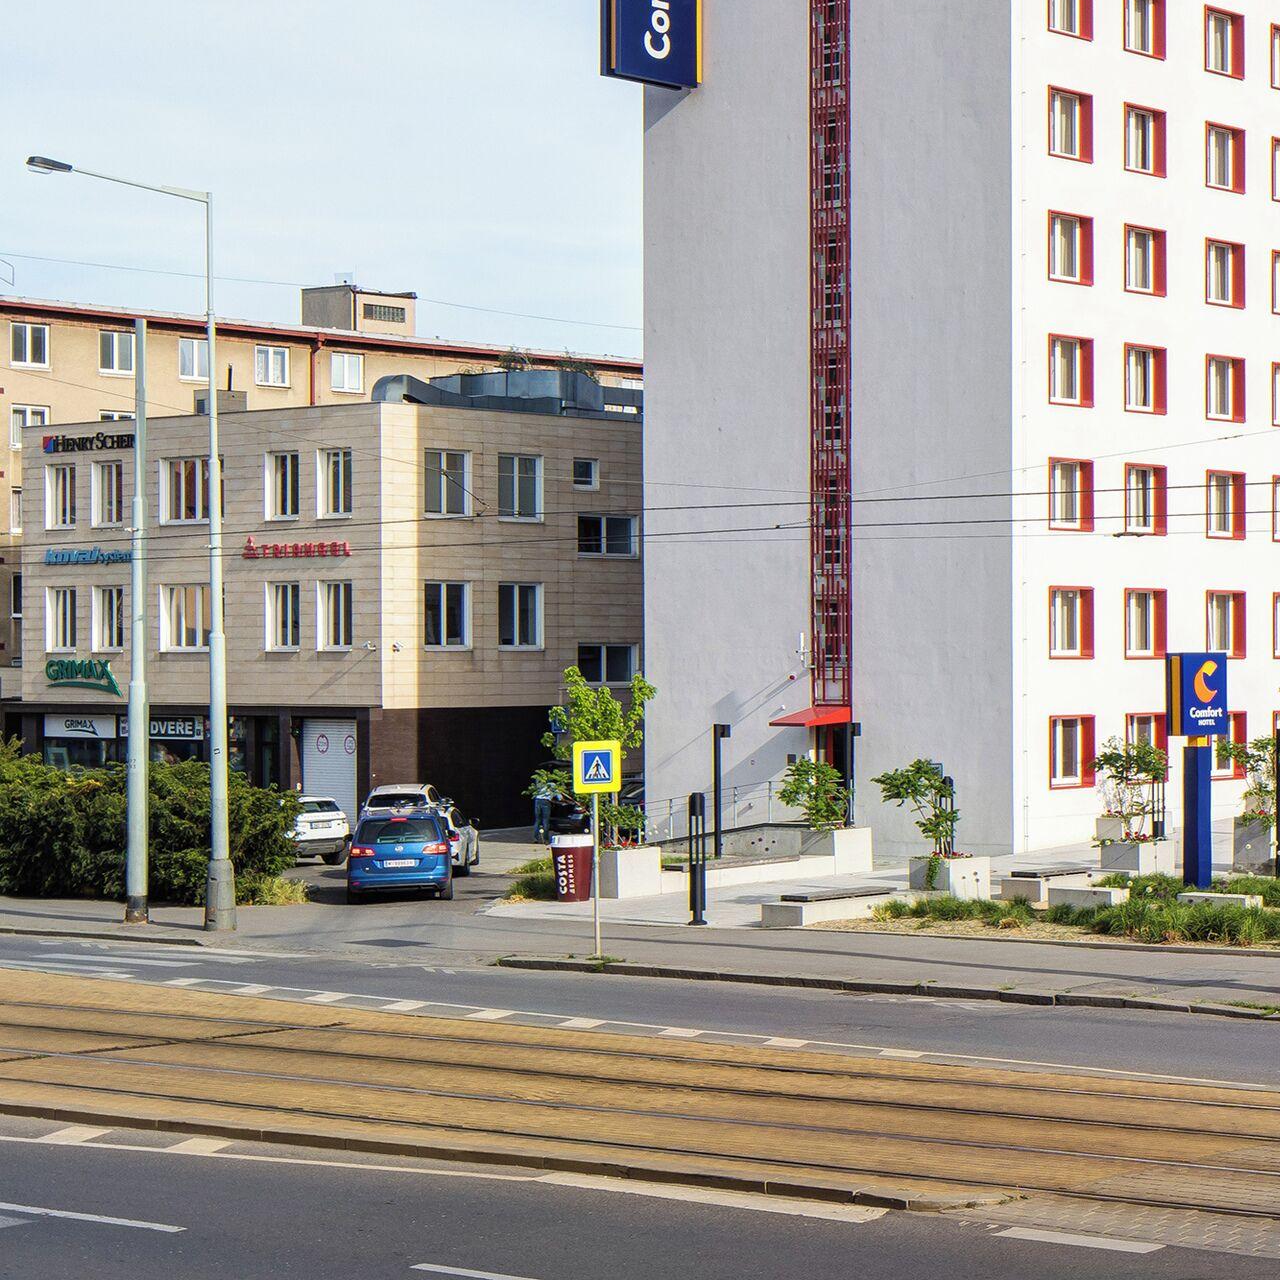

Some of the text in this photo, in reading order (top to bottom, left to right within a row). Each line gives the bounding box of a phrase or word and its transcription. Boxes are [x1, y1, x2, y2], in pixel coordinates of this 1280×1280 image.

[53, 435, 95, 453] HENRY
[46, 659, 121, 693] GRIMAX
[1189, 706, 1223, 718] Comfort
[64, 719, 97, 733] GRIMAX
[557, 854, 568, 895] COSTA
